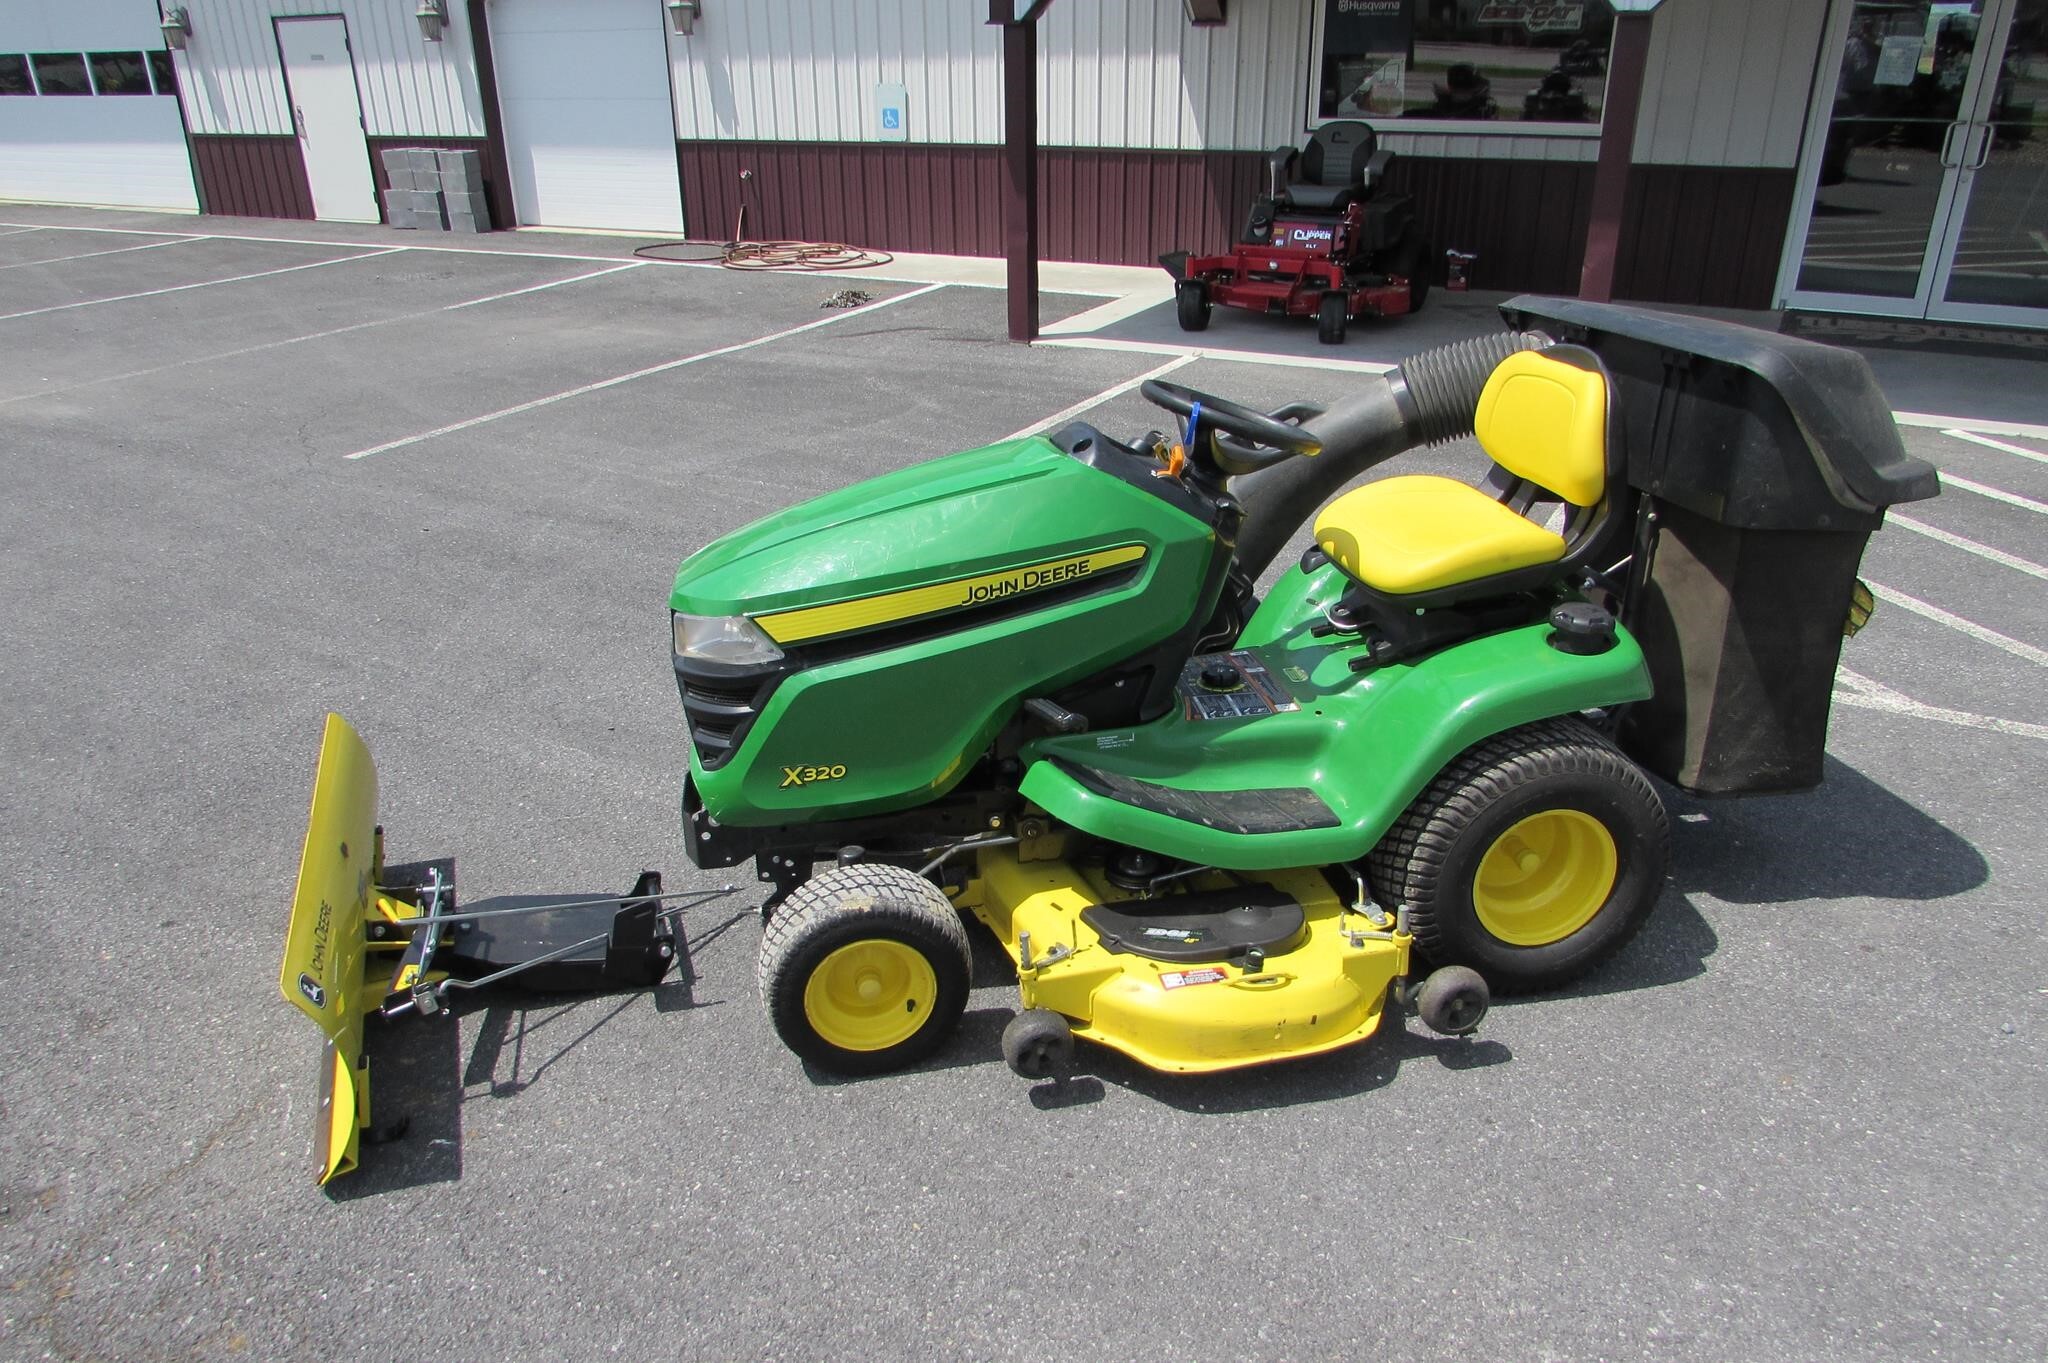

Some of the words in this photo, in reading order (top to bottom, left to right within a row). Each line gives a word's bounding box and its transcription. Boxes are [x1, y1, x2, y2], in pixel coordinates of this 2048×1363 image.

[1349, 1, 1400, 11] Husqvarna
[1294, 229, 1331, 240] CLIPPER
[961, 578, 1019, 606] JOHN
[1023, 559, 1091, 590] DEERE
[780, 764, 847, 788] X320
[314, 899, 332, 942] DEERE
[311, 943, 325, 979] JOHN
